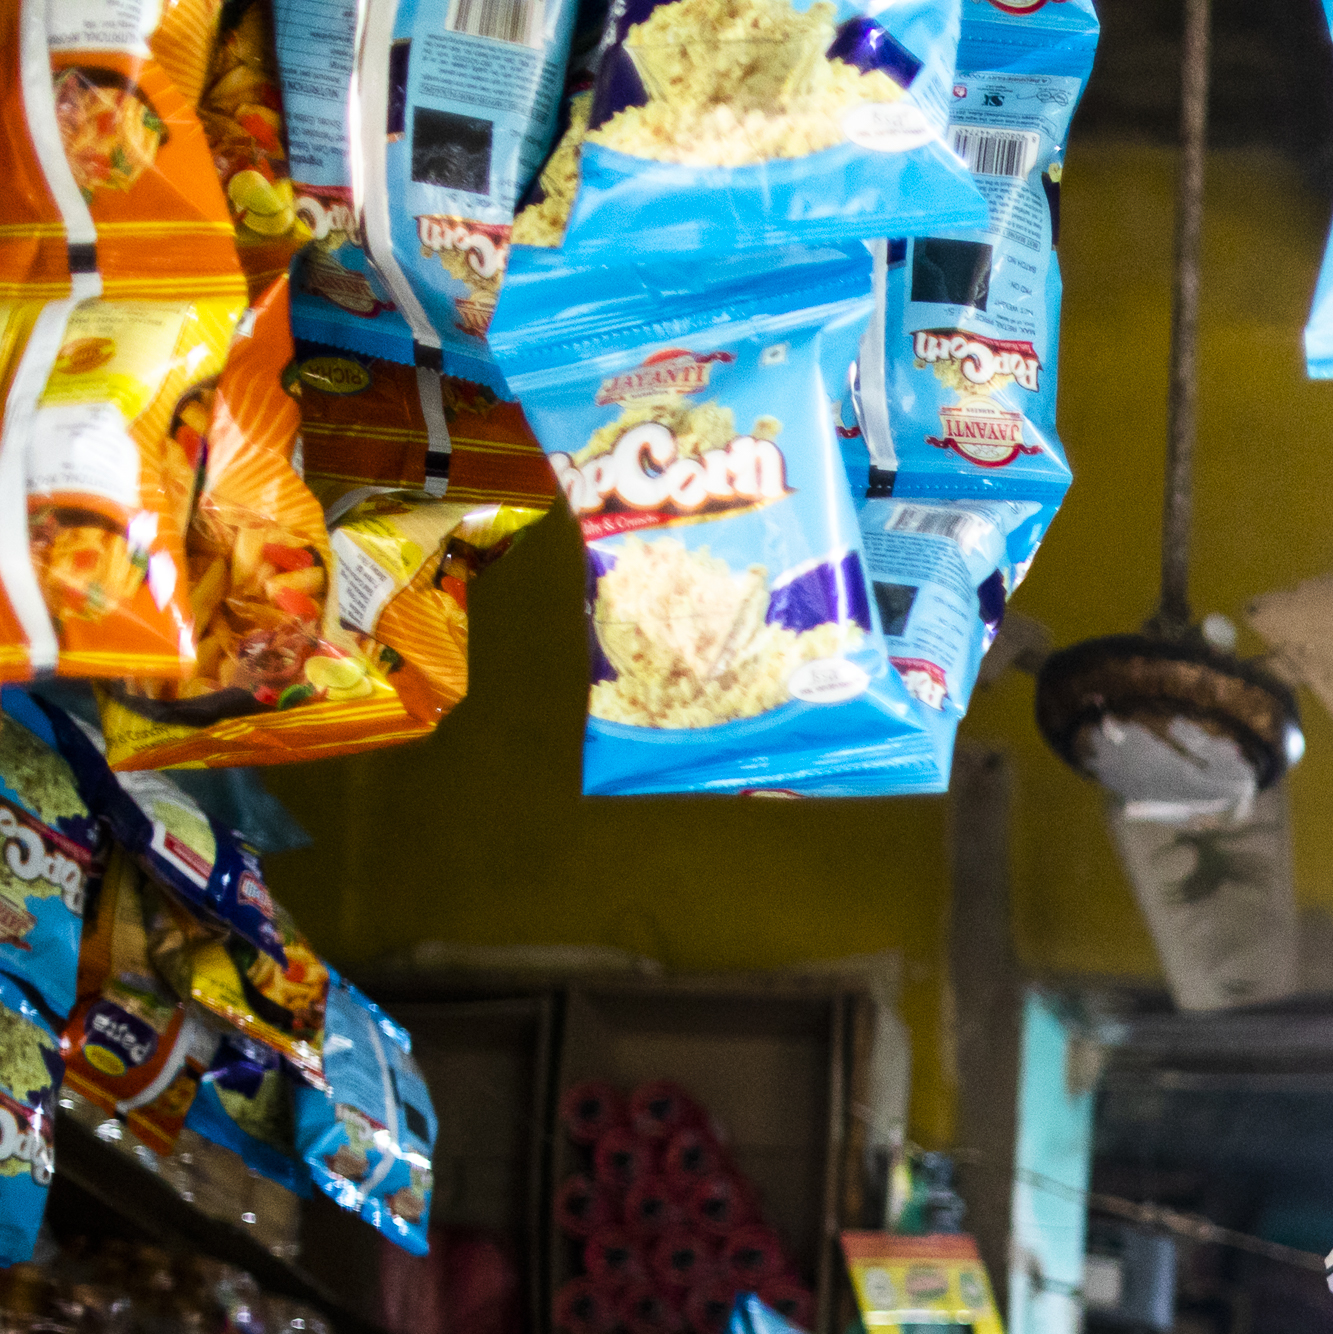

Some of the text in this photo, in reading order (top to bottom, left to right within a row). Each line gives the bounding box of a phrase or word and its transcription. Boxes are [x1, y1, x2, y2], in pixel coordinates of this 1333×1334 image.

[912, 331, 1042, 392] PopCorn
[603, 364, 707, 393] JAYANTI
[945, 418, 1020, 440] JAYANTI
